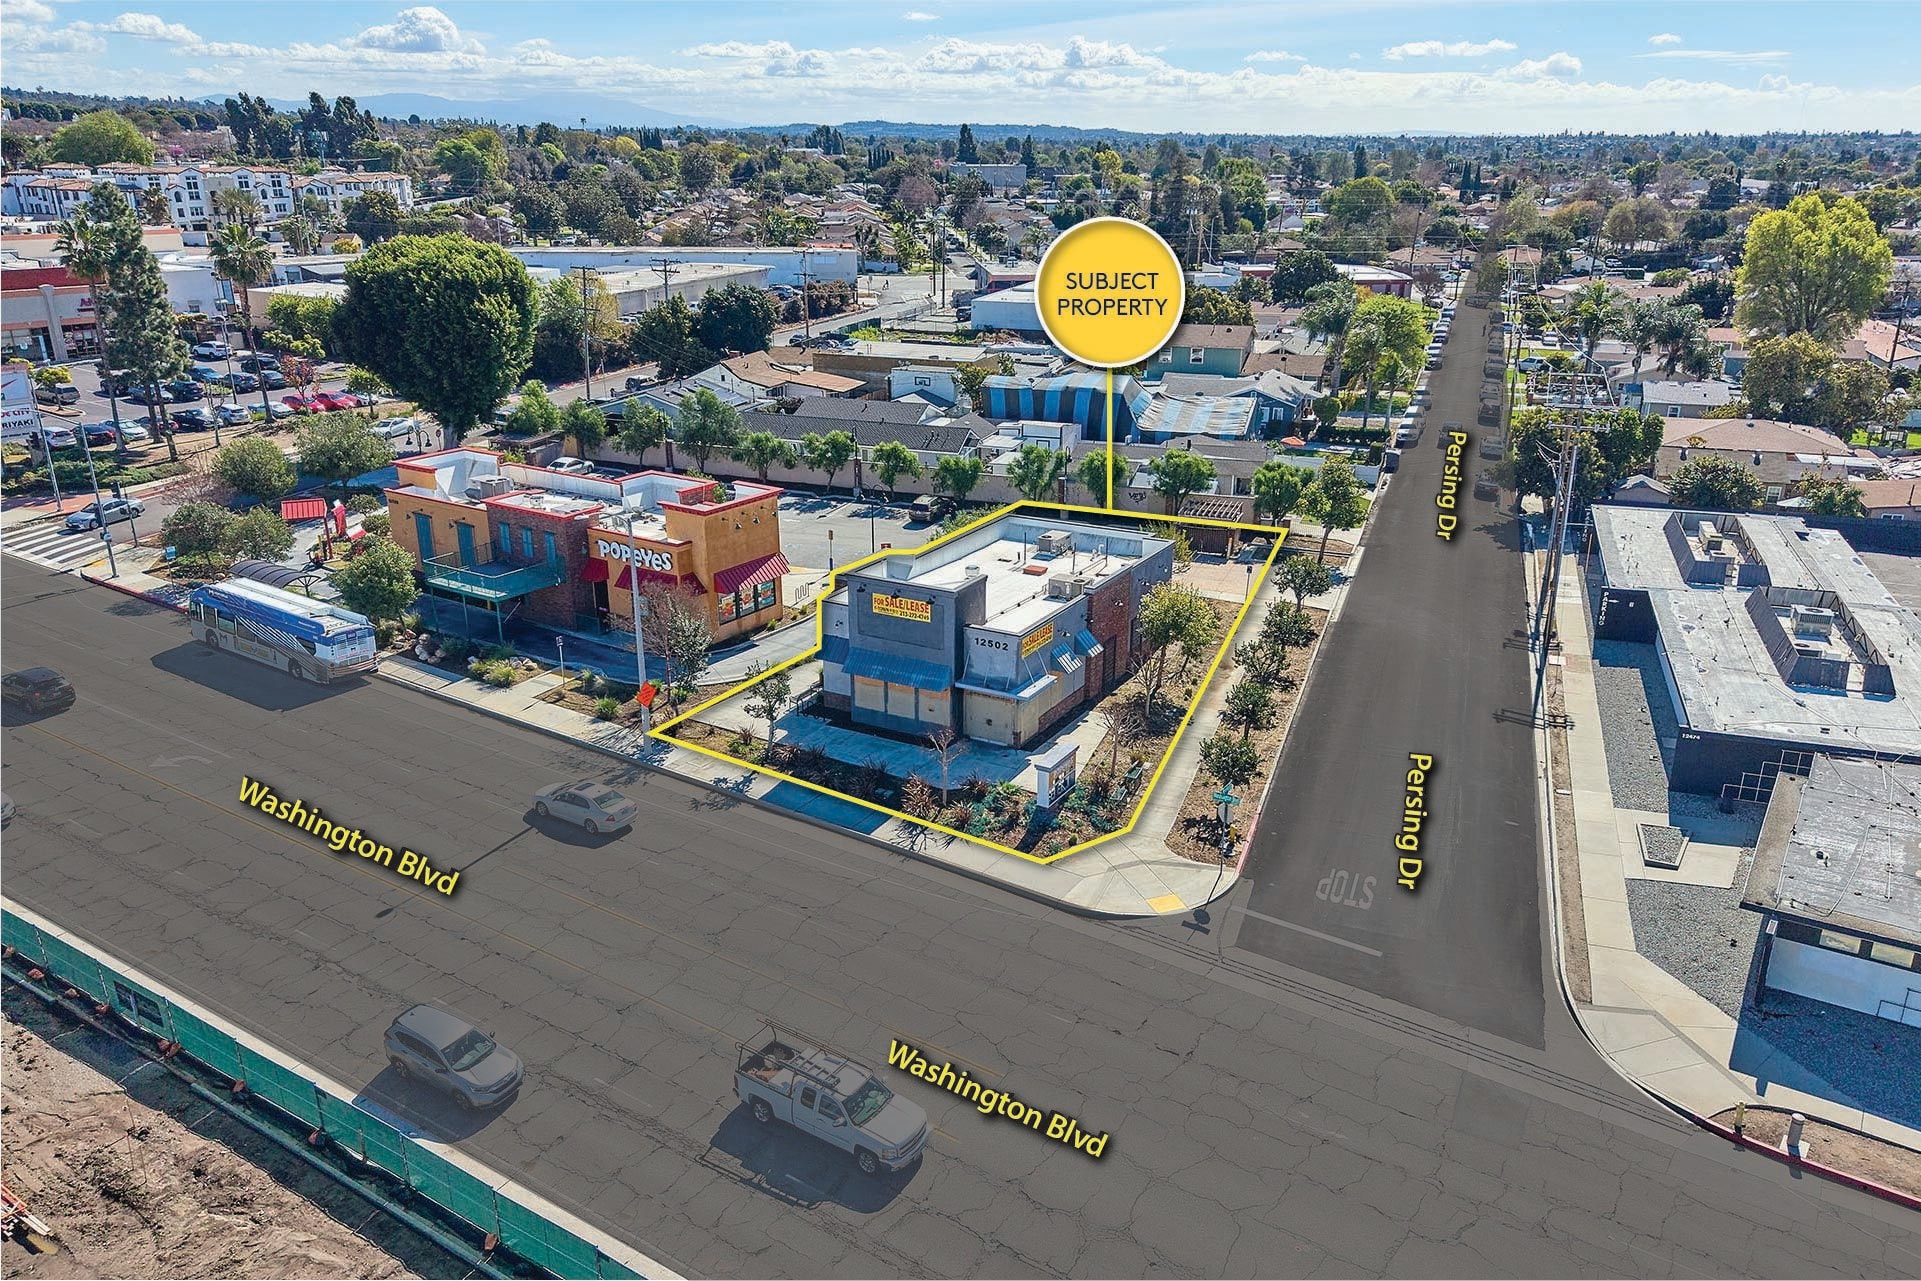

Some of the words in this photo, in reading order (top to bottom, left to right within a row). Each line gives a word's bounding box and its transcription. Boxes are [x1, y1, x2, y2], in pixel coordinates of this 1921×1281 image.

[874, 597, 884, 606] FOR
[885, 597, 929, 613] SALE/LEASE
[1599, 591, 1609, 625] PARKING
[975, 637, 1009, 651] 12502
[1315, 868, 1377, 910] STOP
